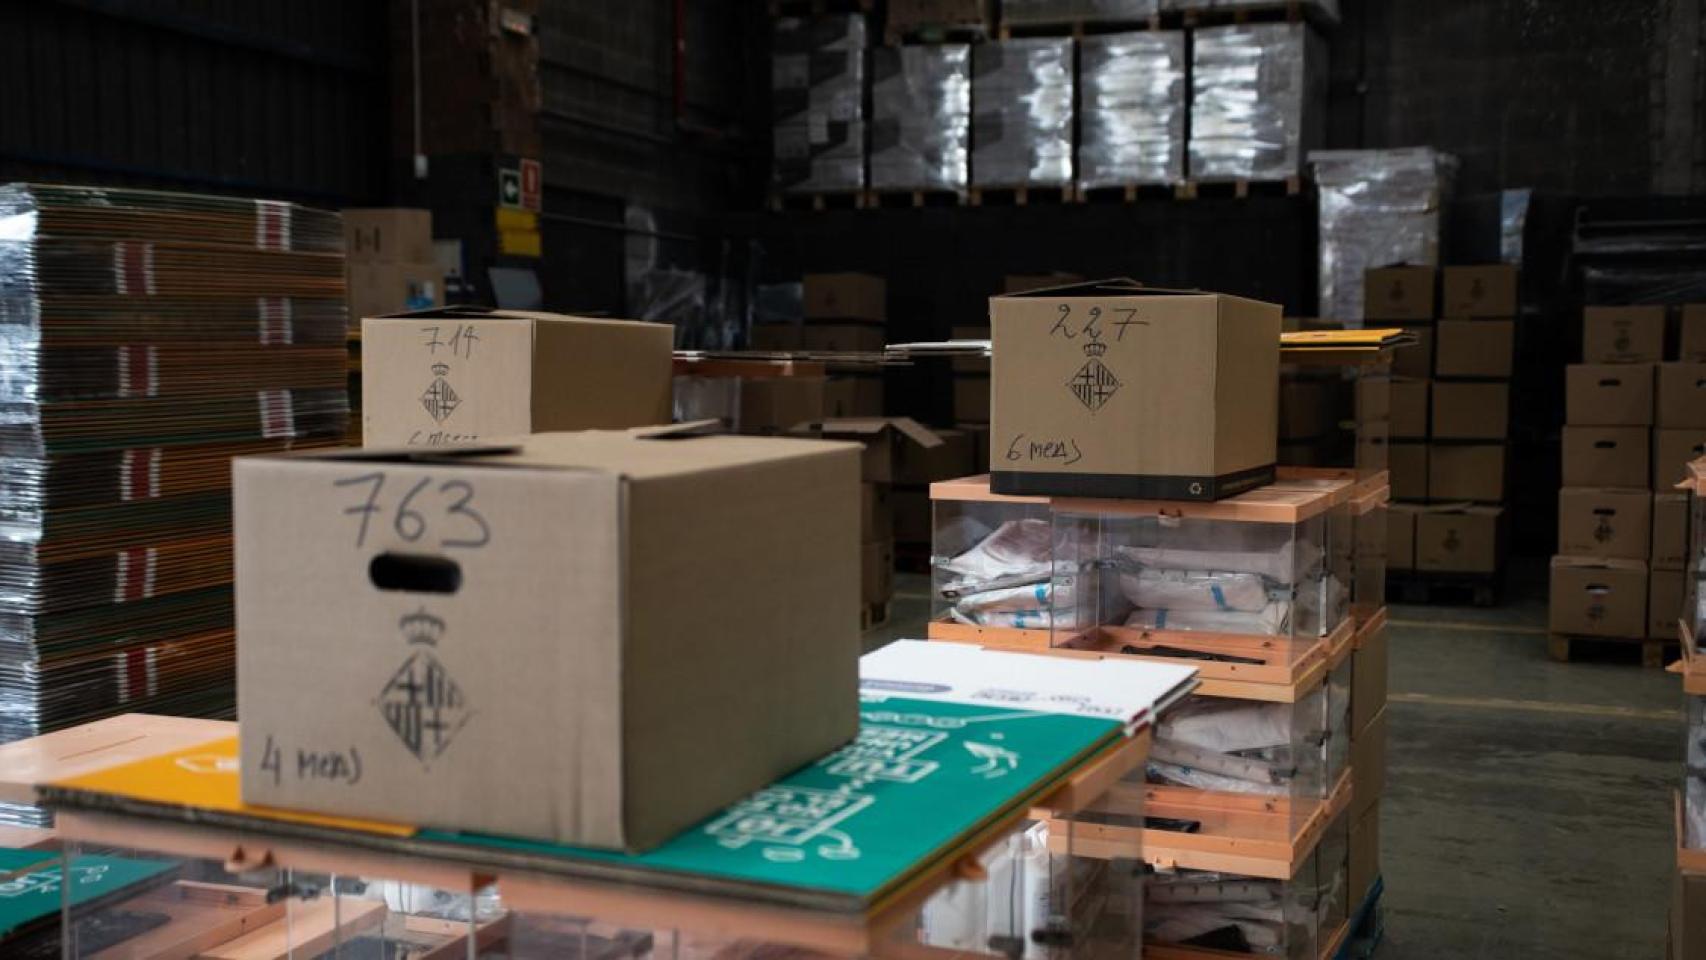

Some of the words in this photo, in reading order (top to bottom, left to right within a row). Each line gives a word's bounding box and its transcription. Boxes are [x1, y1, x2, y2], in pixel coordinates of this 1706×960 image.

[1049, 303, 1150, 341] 227
[1006, 433, 1024, 461] 6
[334, 472, 490, 550] 763
[260, 734, 281, 787] 4
